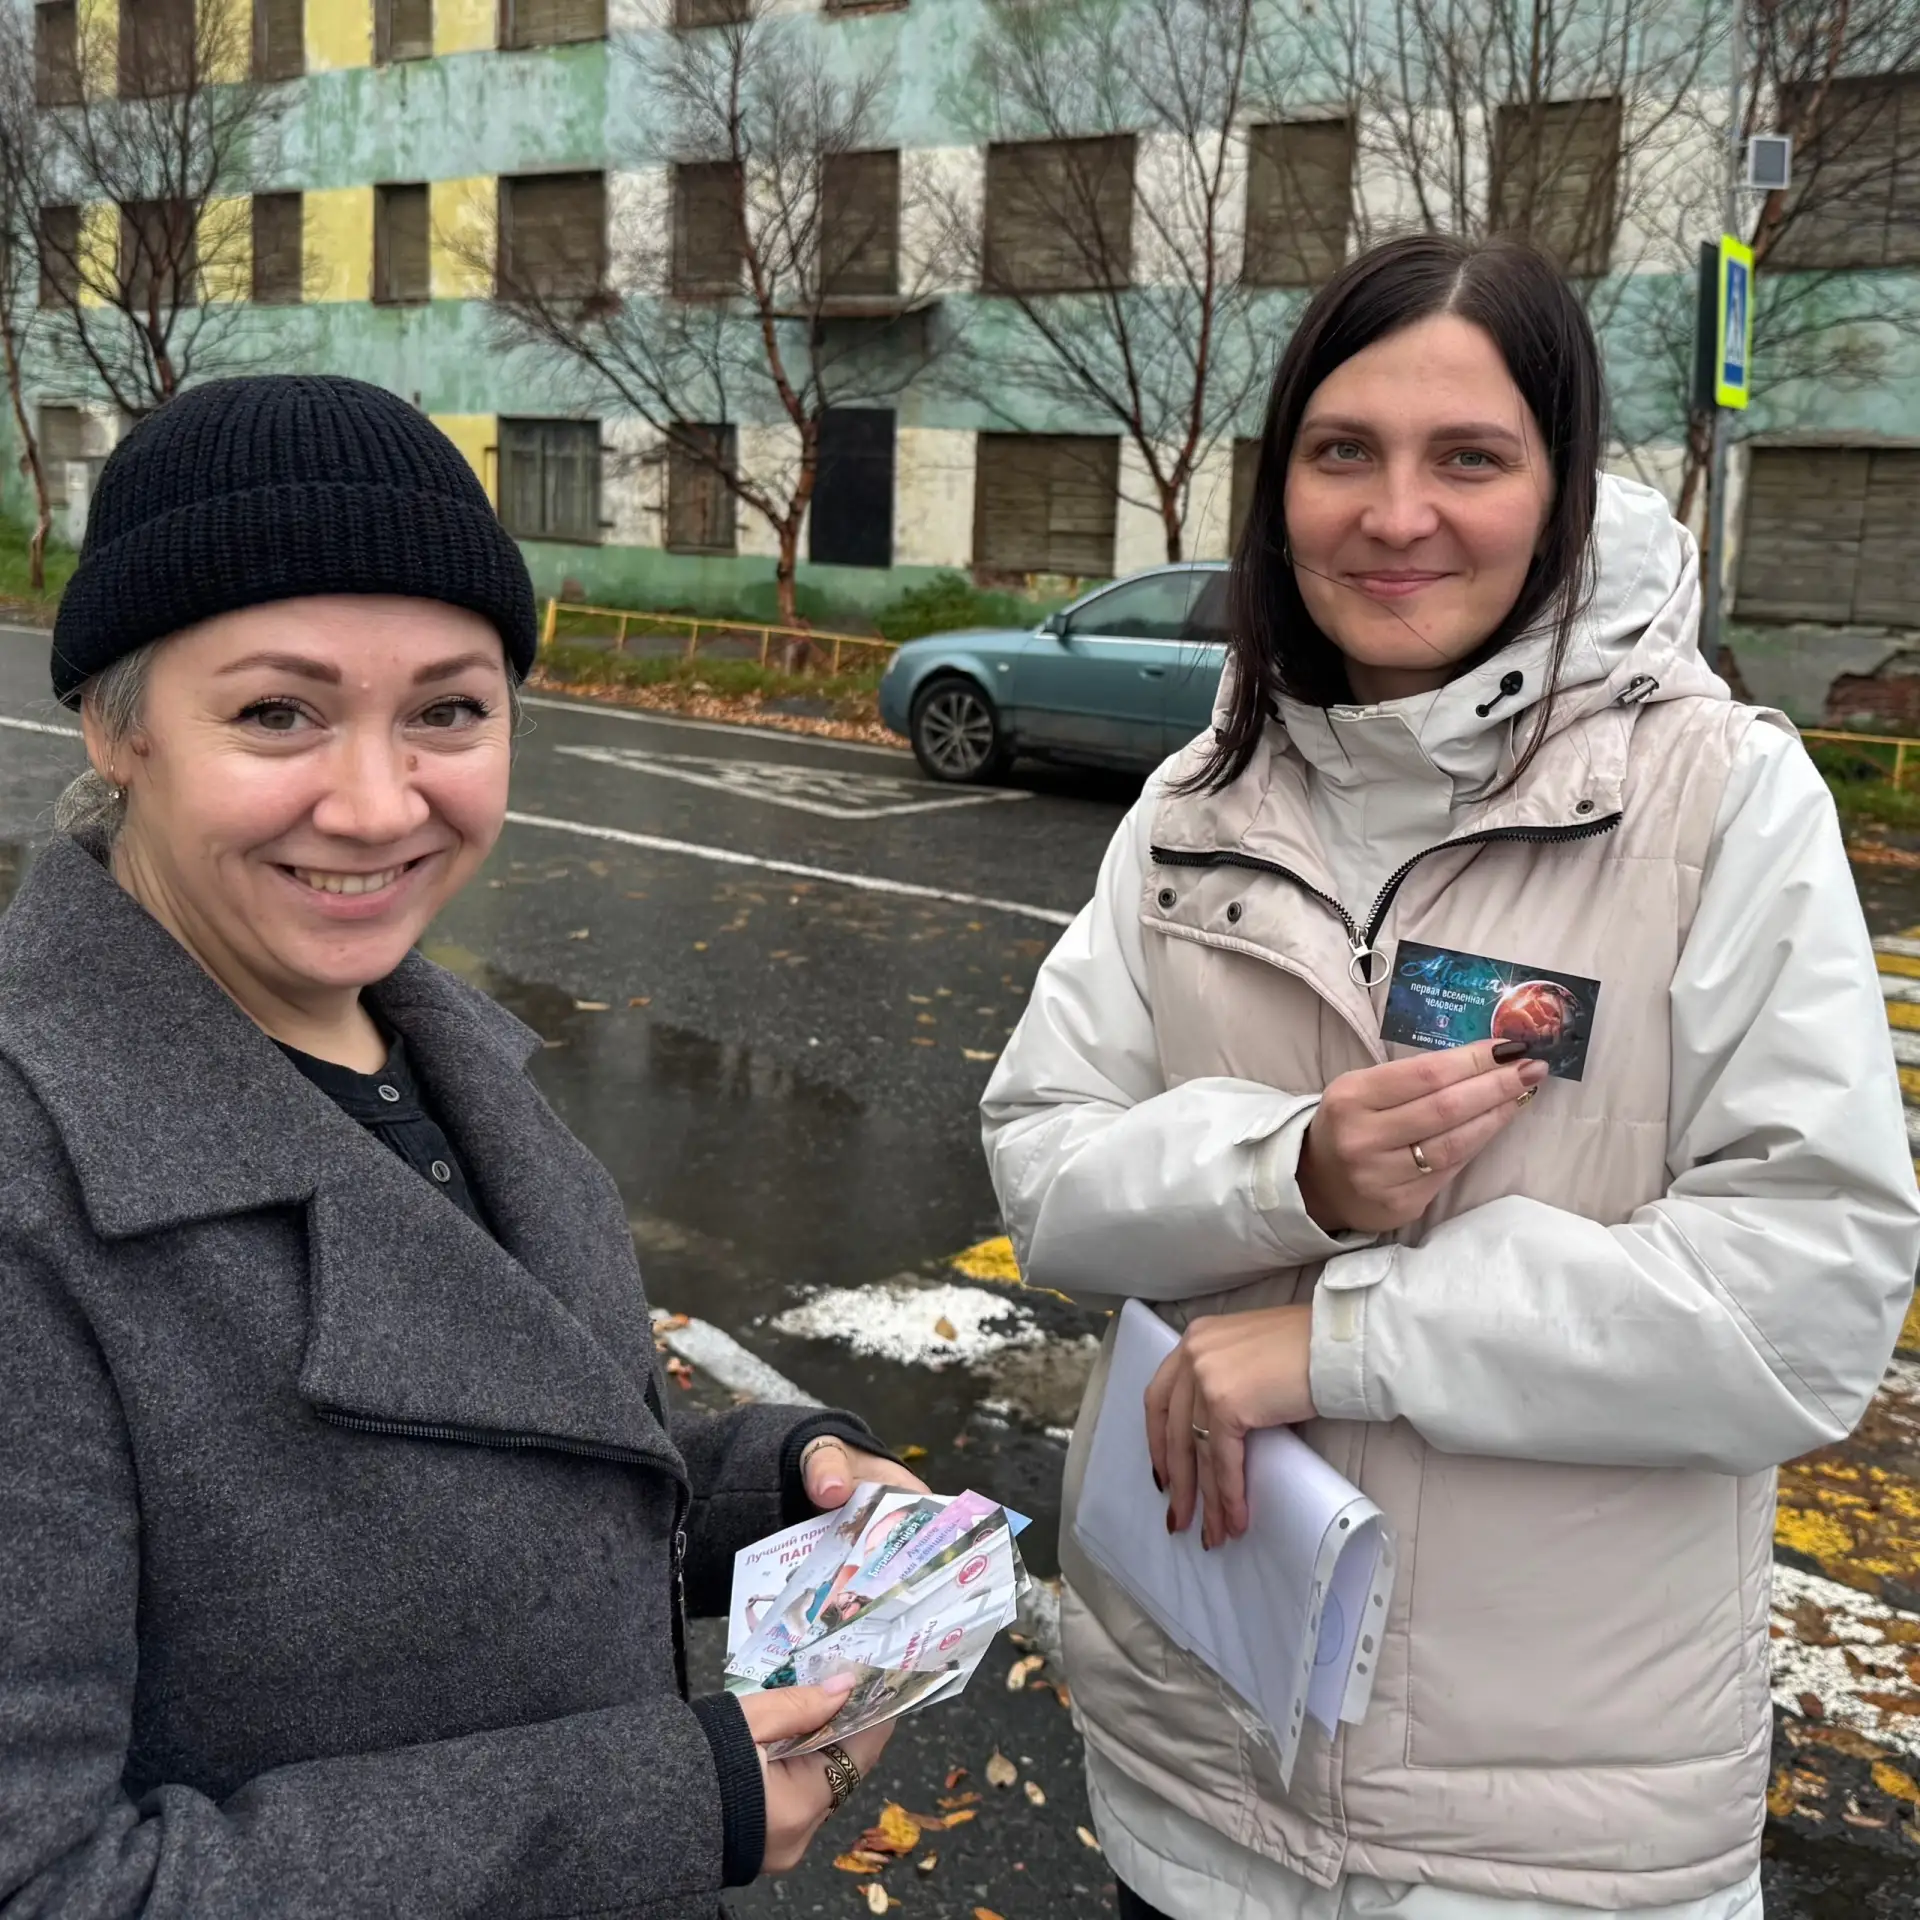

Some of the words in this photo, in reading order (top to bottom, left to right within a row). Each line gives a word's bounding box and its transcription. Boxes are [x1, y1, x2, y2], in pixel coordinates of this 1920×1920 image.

[1410, 982, 1441, 997] первая
[1441, 989, 1486, 1006] вселенная
[1425, 996, 1467, 1013] человека!
[745, 1535, 798, 1567] Лучший
[779, 1542, 818, 1565] ПАП
